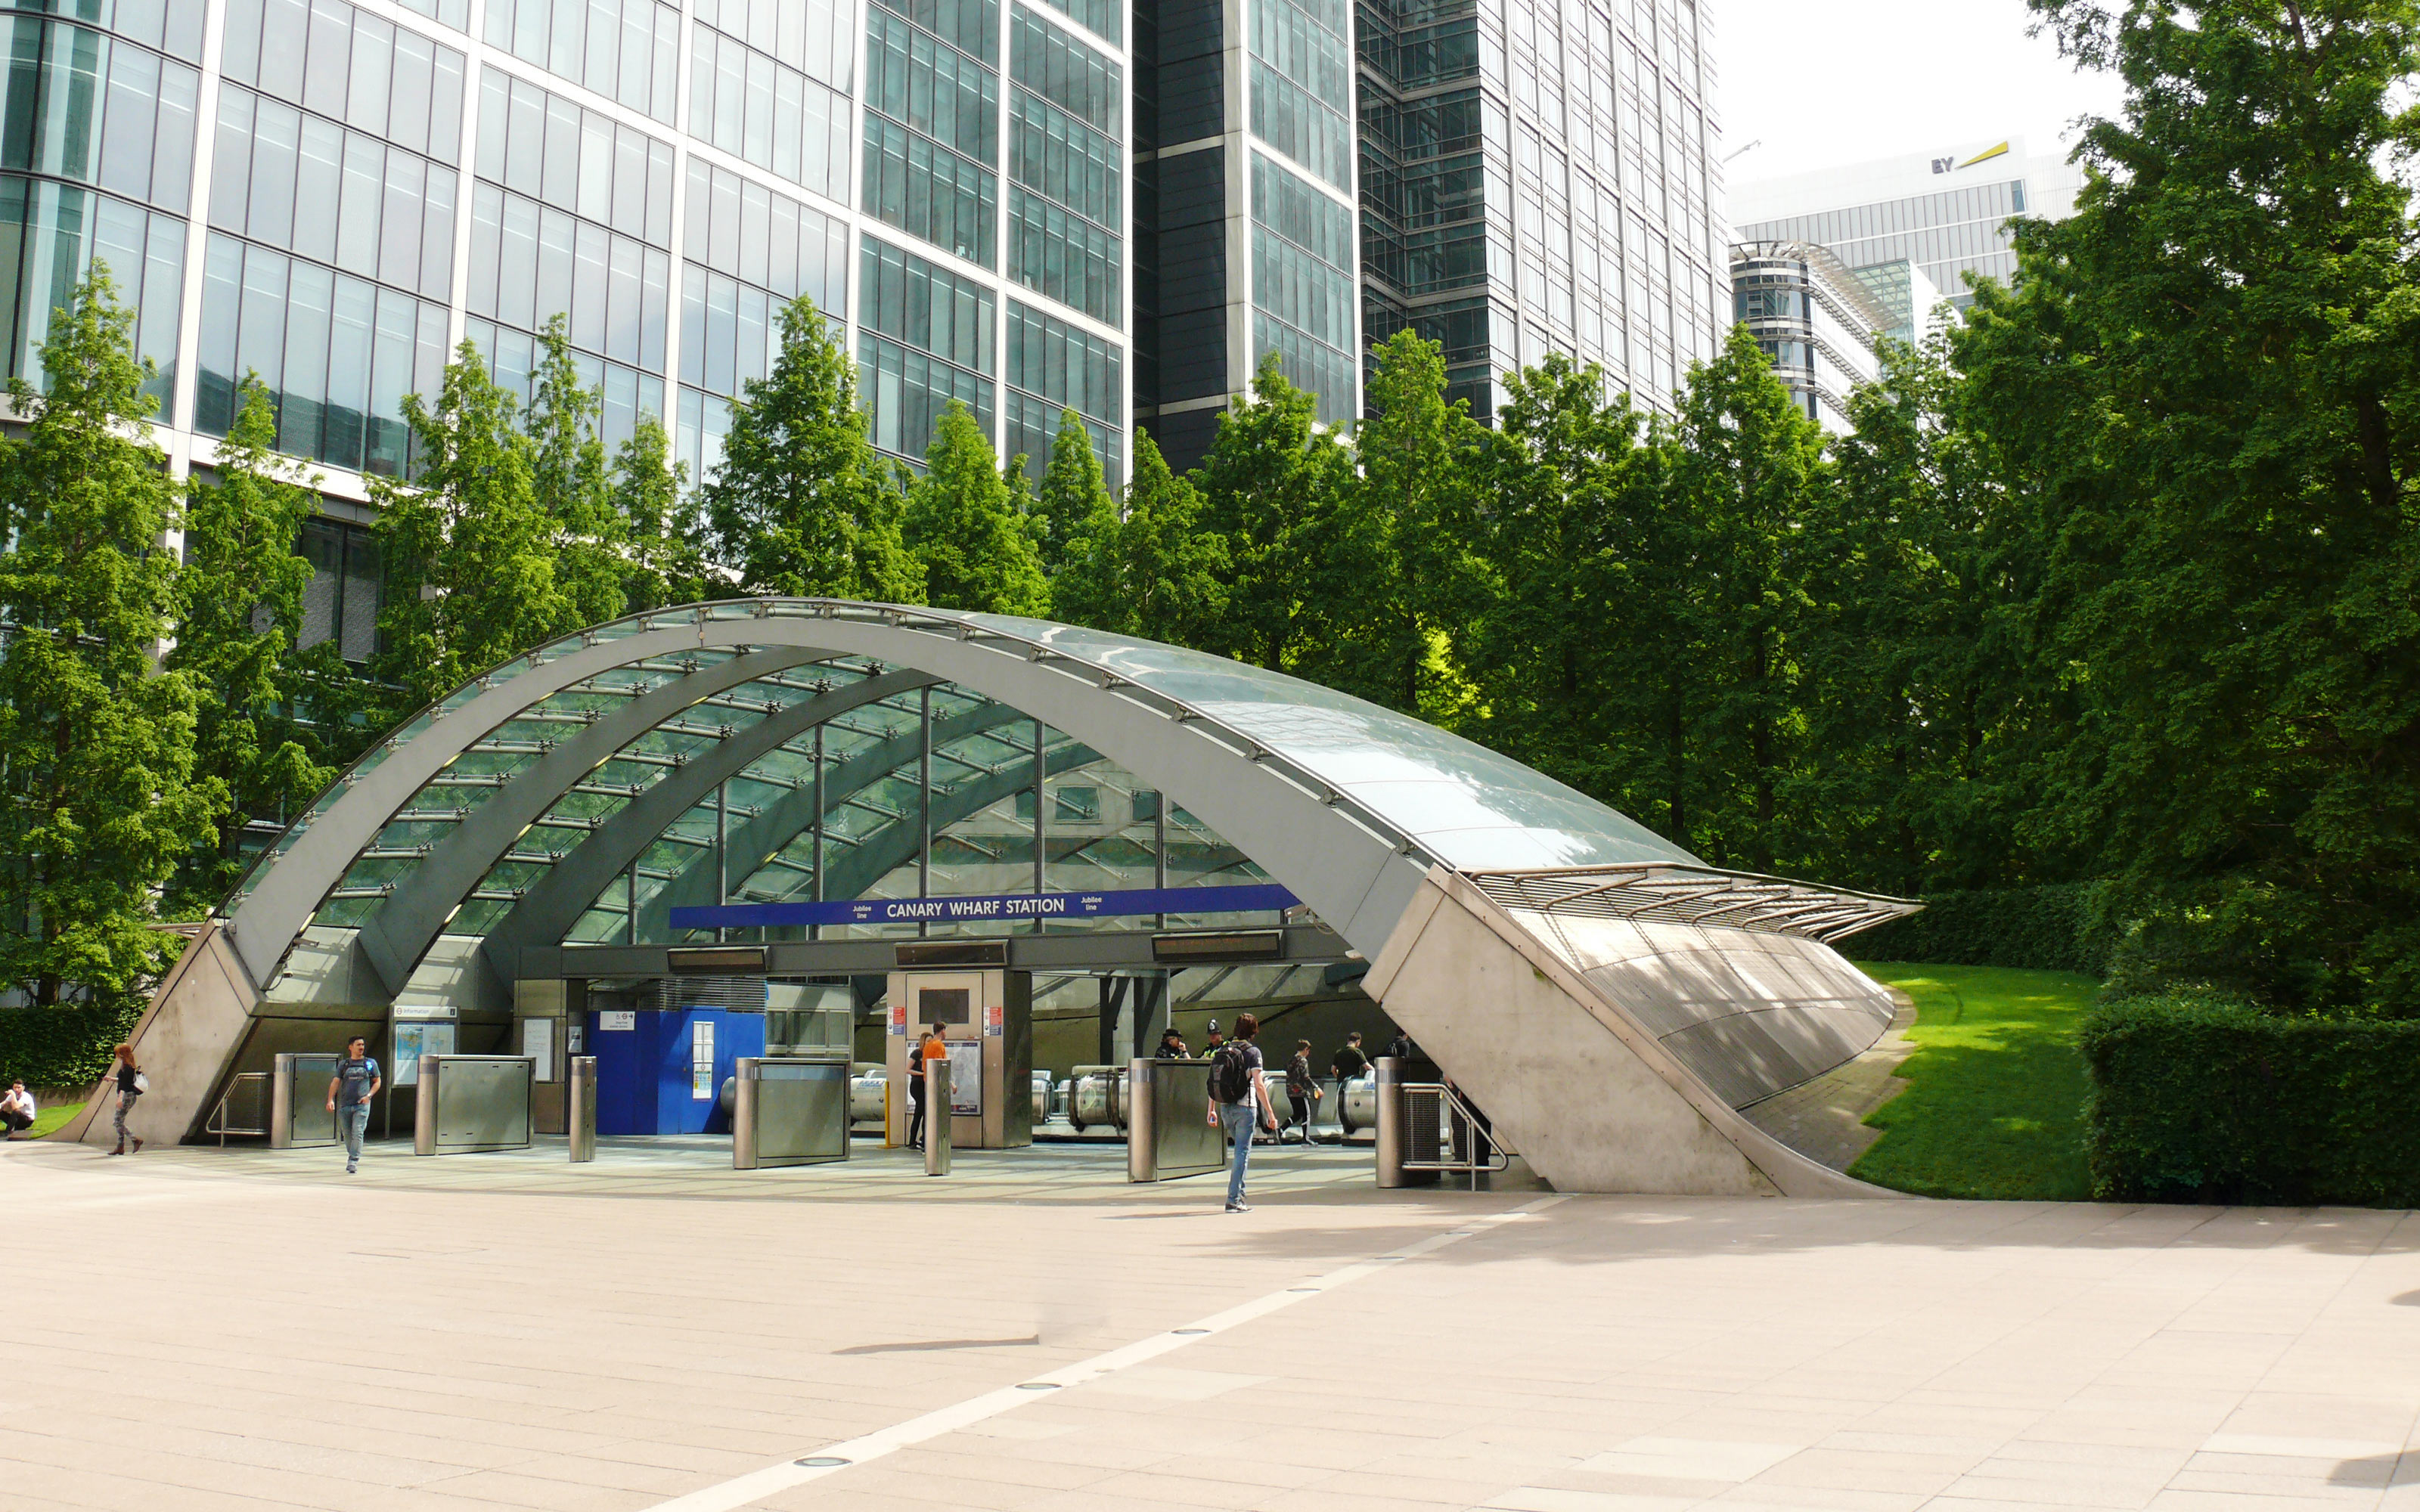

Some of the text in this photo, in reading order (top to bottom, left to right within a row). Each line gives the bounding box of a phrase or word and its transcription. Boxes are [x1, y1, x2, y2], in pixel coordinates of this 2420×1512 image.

[1931, 156, 1953, 174] EY
[886, 898, 1064, 918] CANARY WHARF STATION
